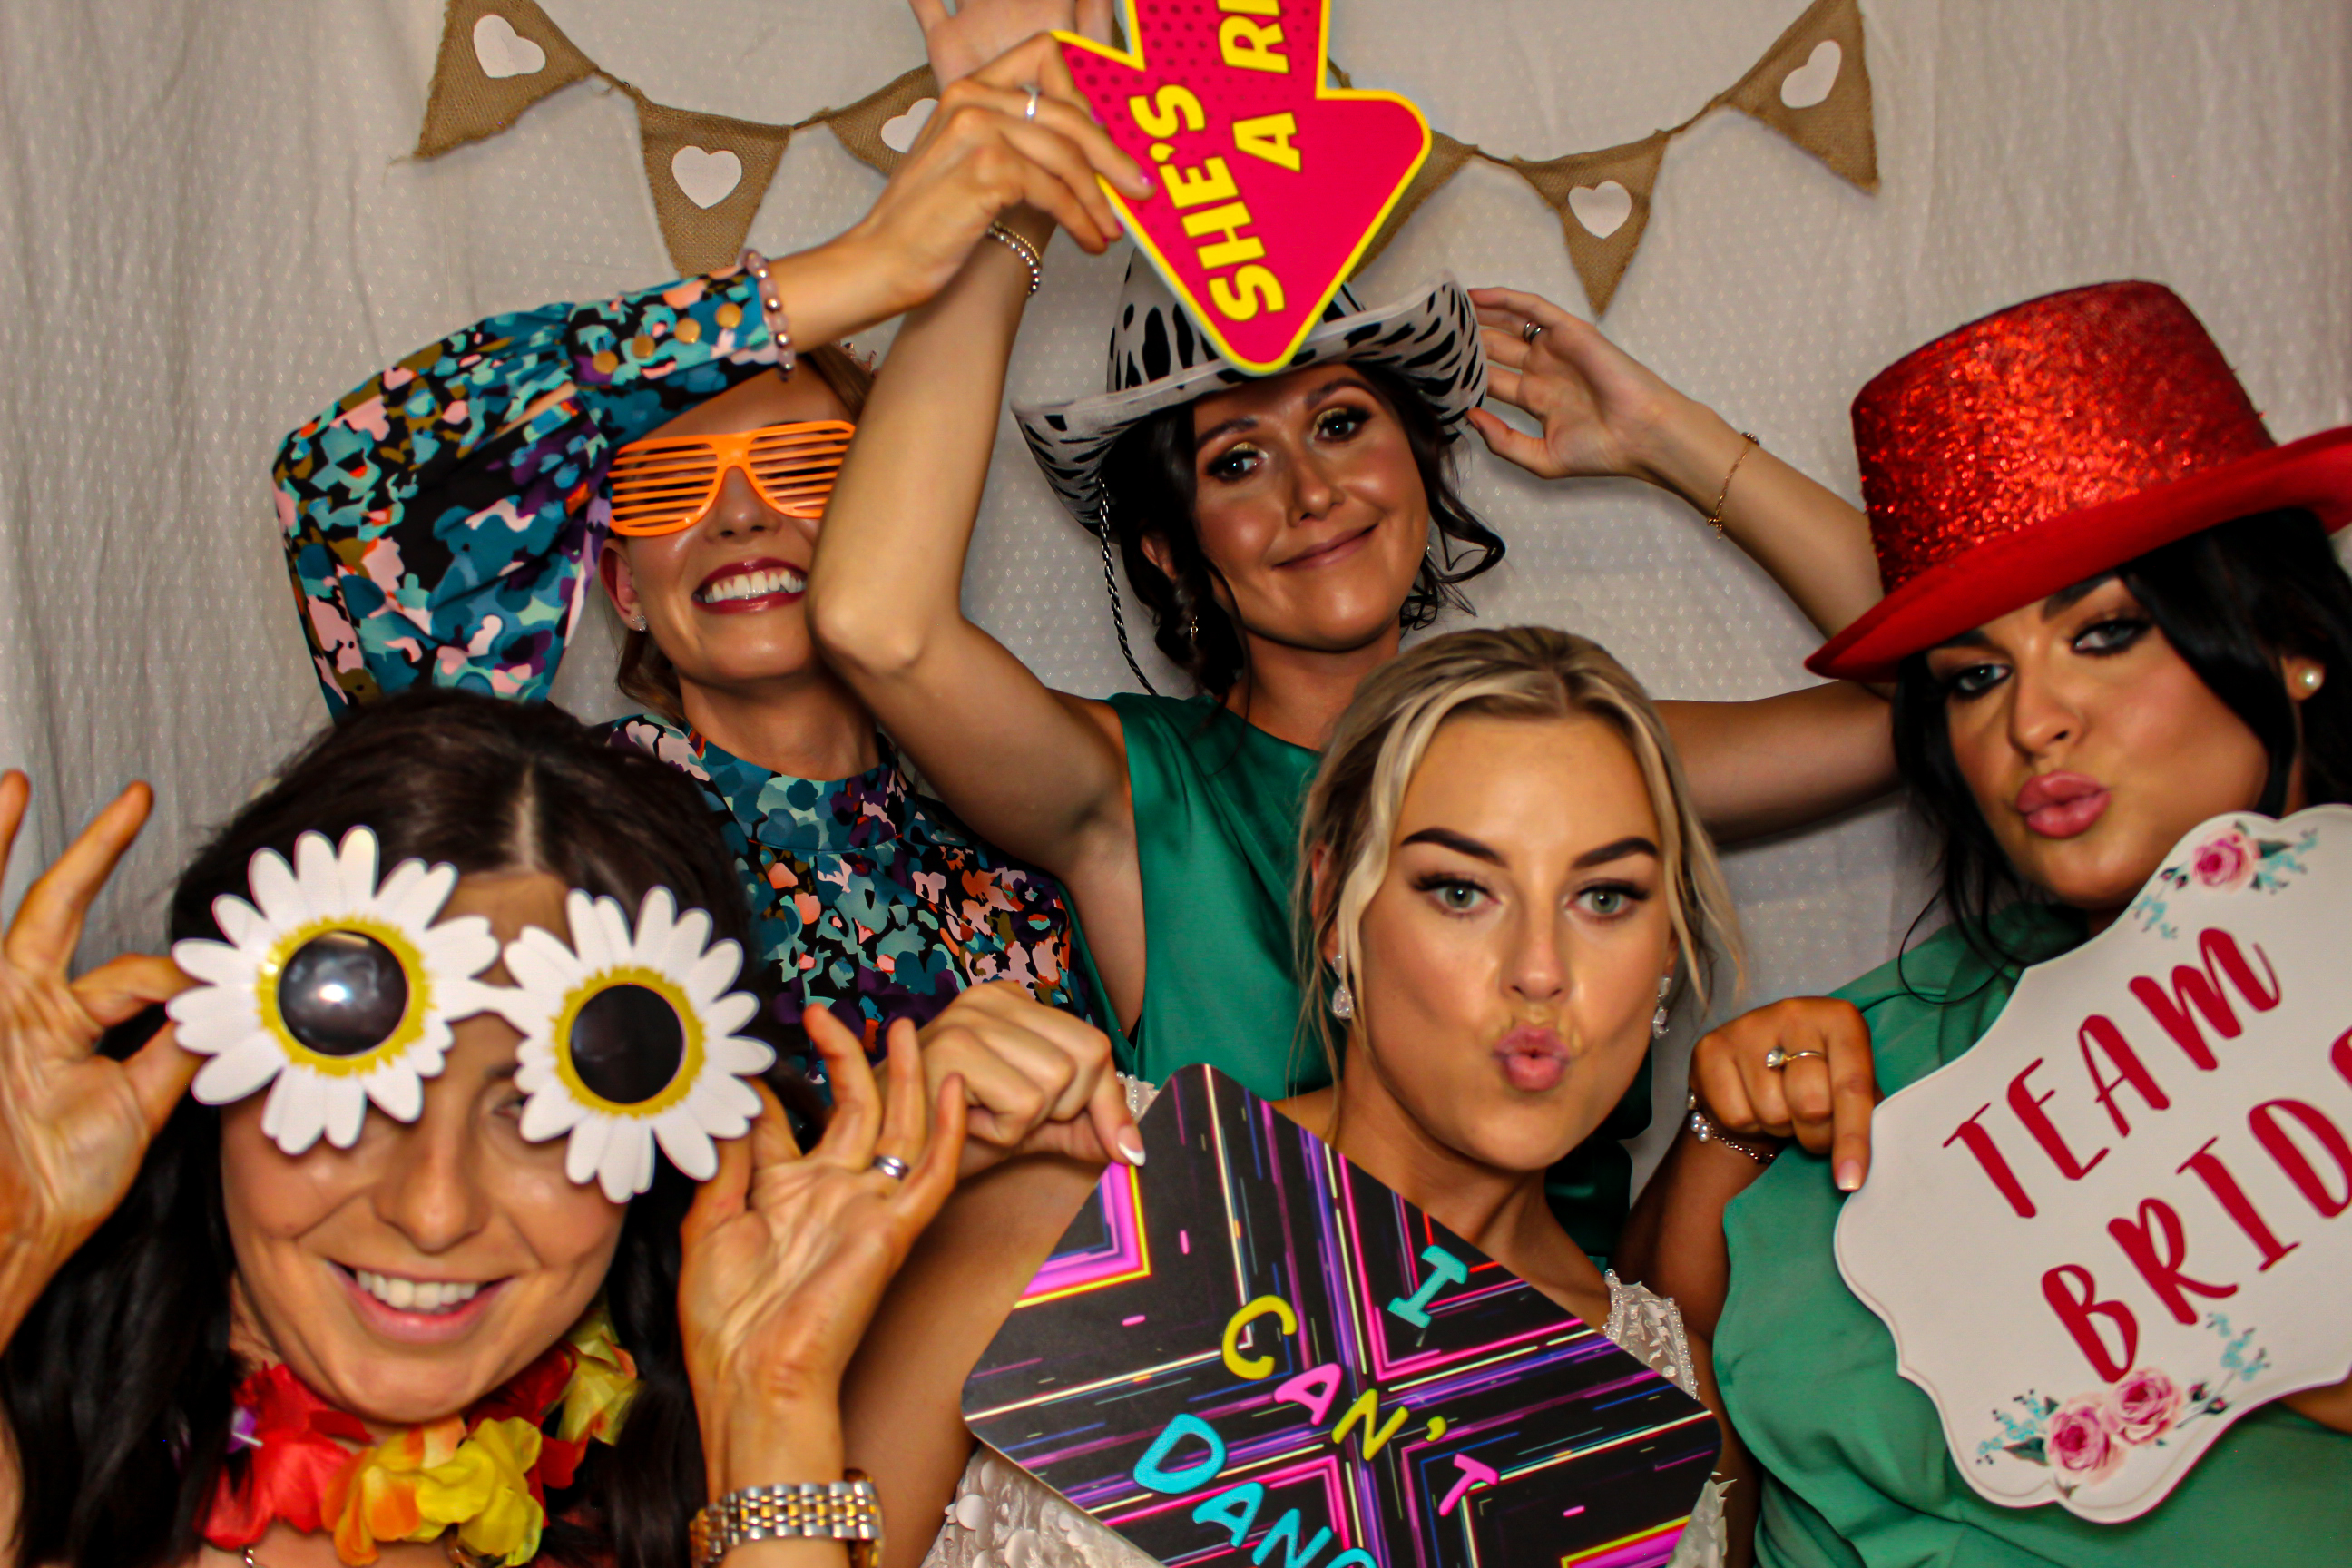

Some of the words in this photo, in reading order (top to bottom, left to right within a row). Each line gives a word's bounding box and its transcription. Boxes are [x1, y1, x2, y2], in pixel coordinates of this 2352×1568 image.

[1128, 84, 1286, 322] SHE'S
[1232, 112, 1302, 172] A
[1943, 926, 2281, 1219] TEAM
[1387, 1244, 1468, 1328] I
[2042, 1024, 2352, 1384] BRID
[1221, 1295, 1500, 1516] CAN'T
